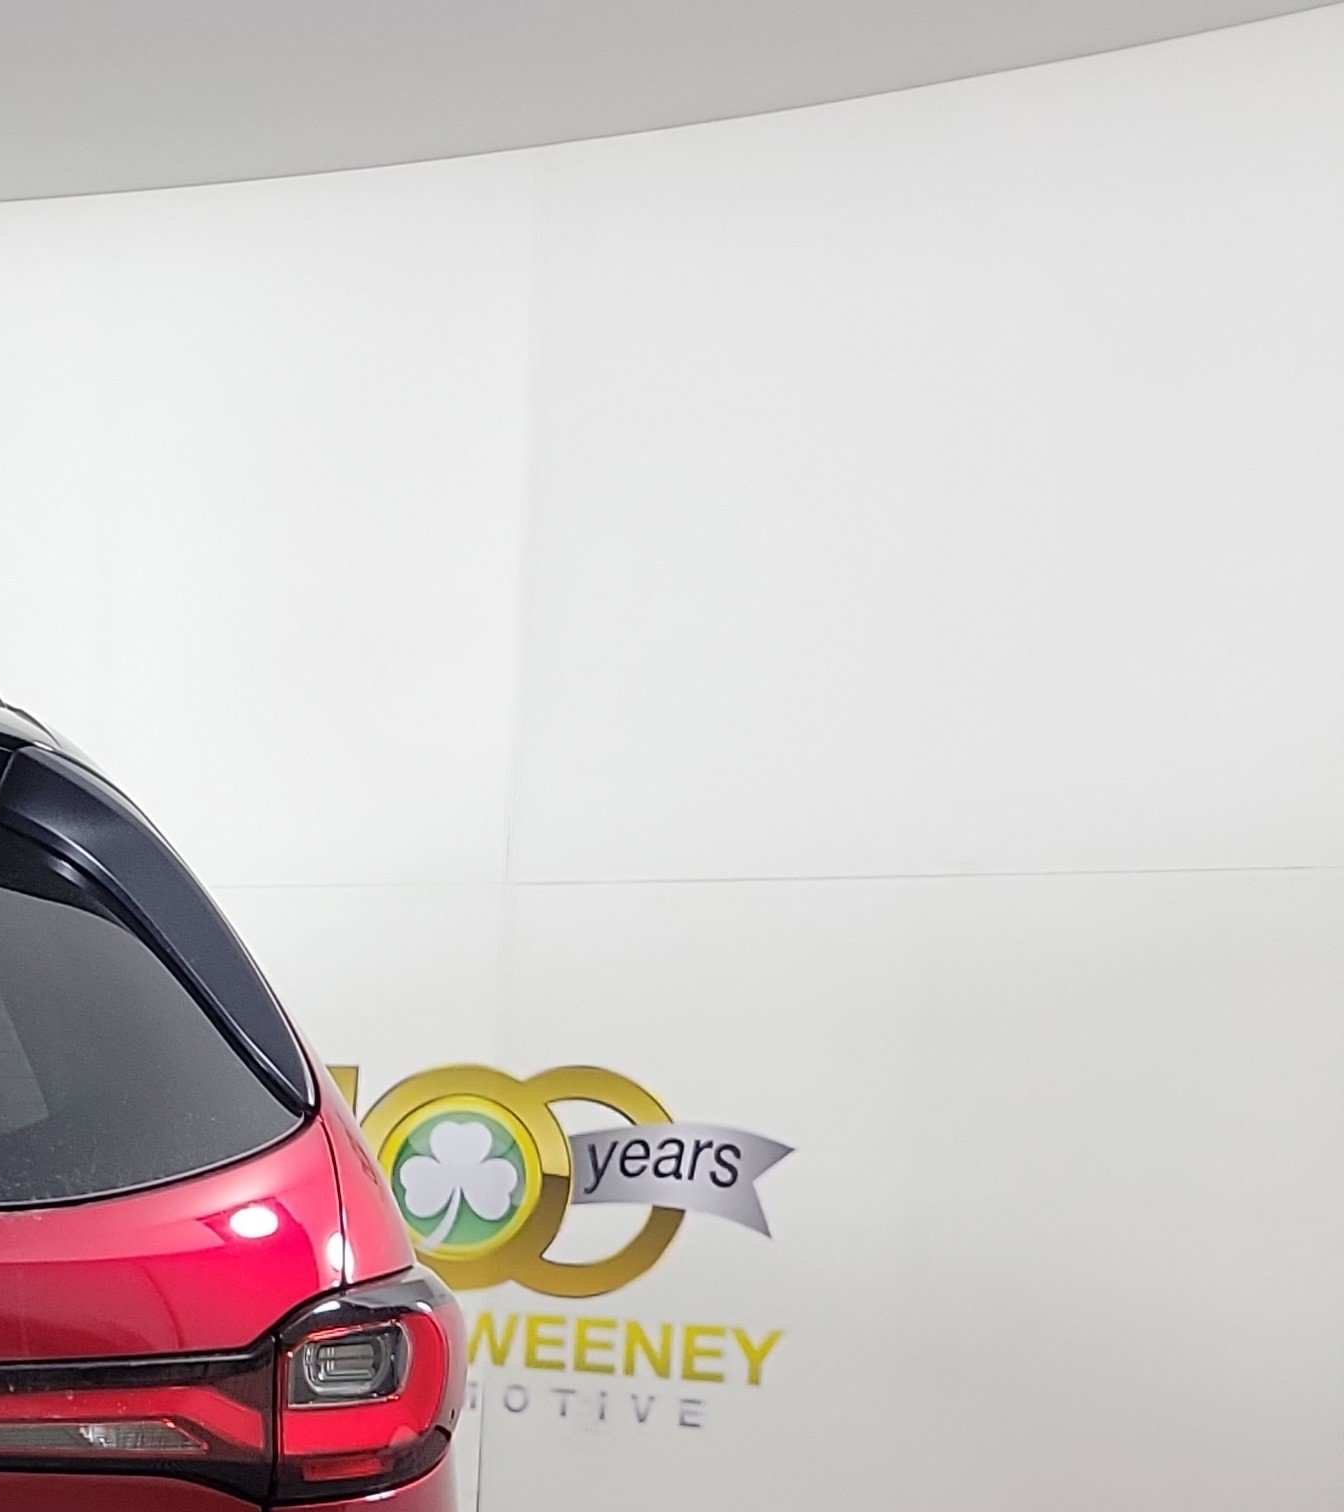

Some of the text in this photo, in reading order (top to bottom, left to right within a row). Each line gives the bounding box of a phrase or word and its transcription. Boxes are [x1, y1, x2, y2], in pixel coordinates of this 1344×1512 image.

[327, 1064, 742, 1298] 00 years
[466, 1311, 784, 1386] WEENEY
